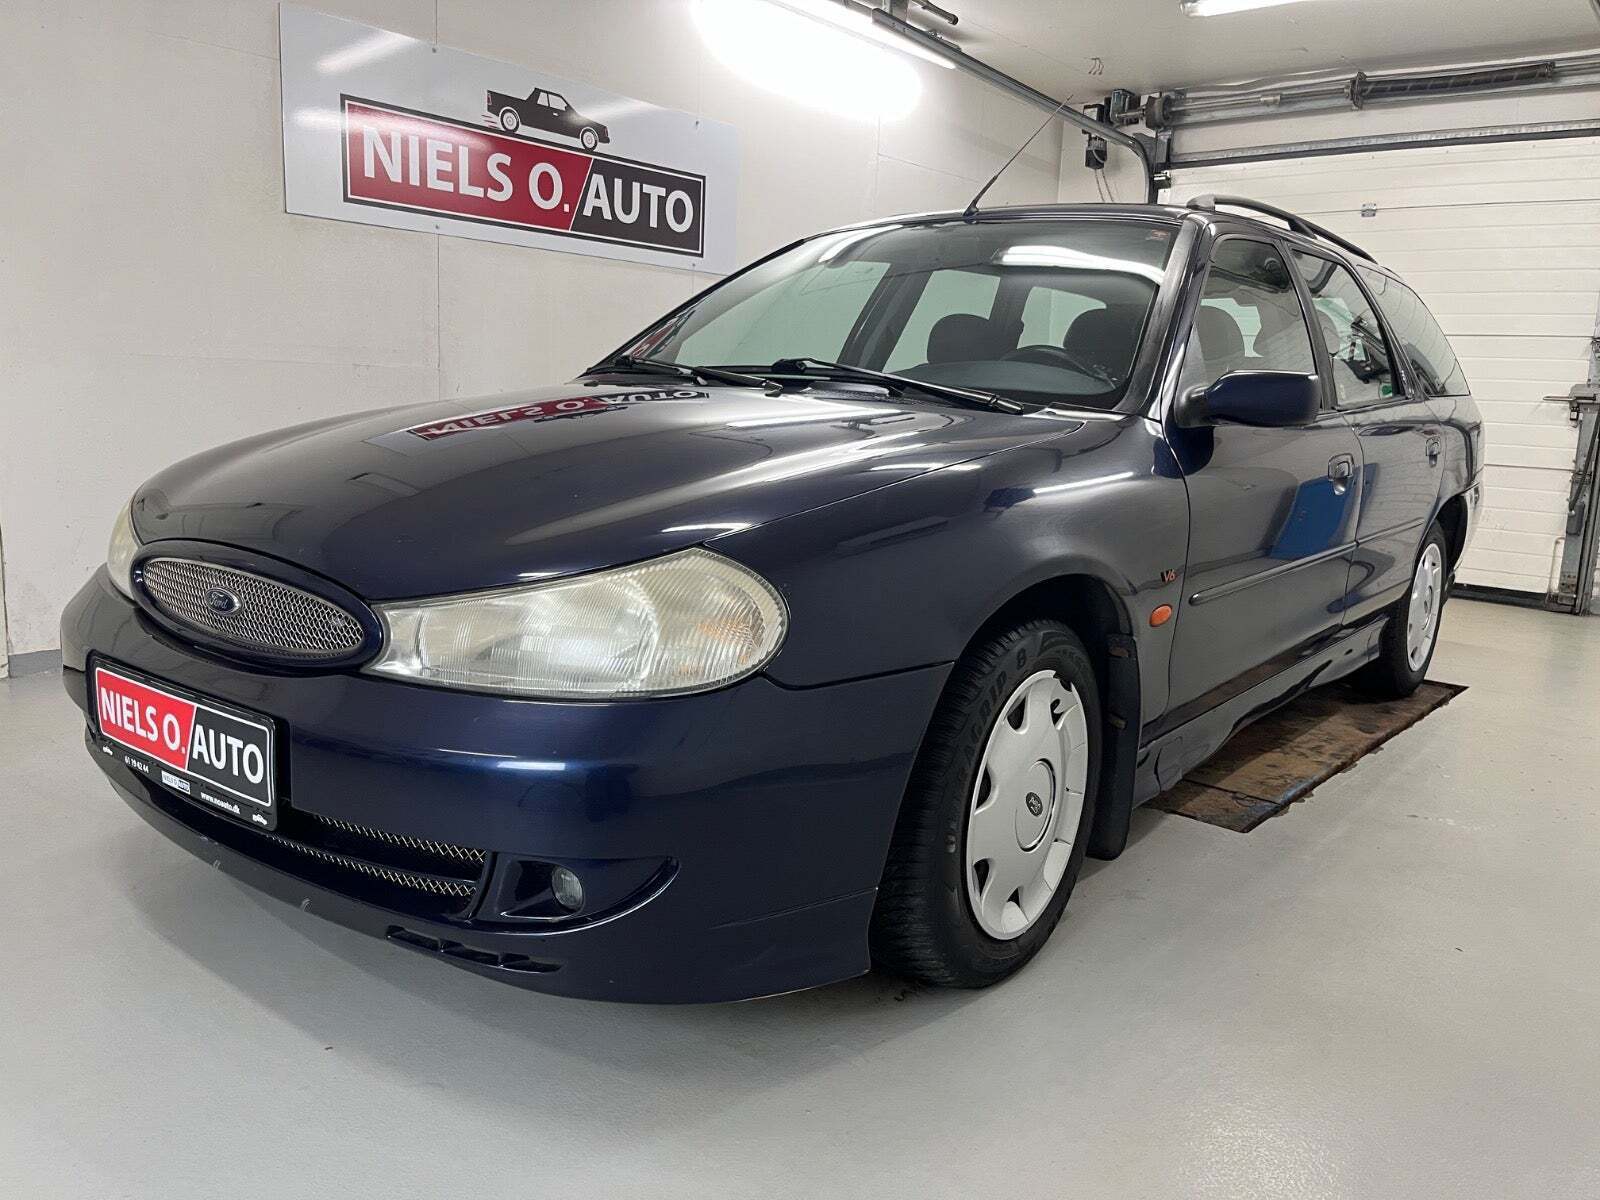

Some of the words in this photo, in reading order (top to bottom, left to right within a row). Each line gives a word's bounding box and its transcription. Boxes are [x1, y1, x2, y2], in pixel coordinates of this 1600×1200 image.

[362, 126, 513, 202] NIELS
[528, 162, 570, 213] O.
[583, 172, 694, 233] AUTO
[1161, 569, 1176, 583] V6
[101, 687, 159, 742] NIELS
[162, 713, 186, 755] O.
[192, 723, 264, 785] AUTO
